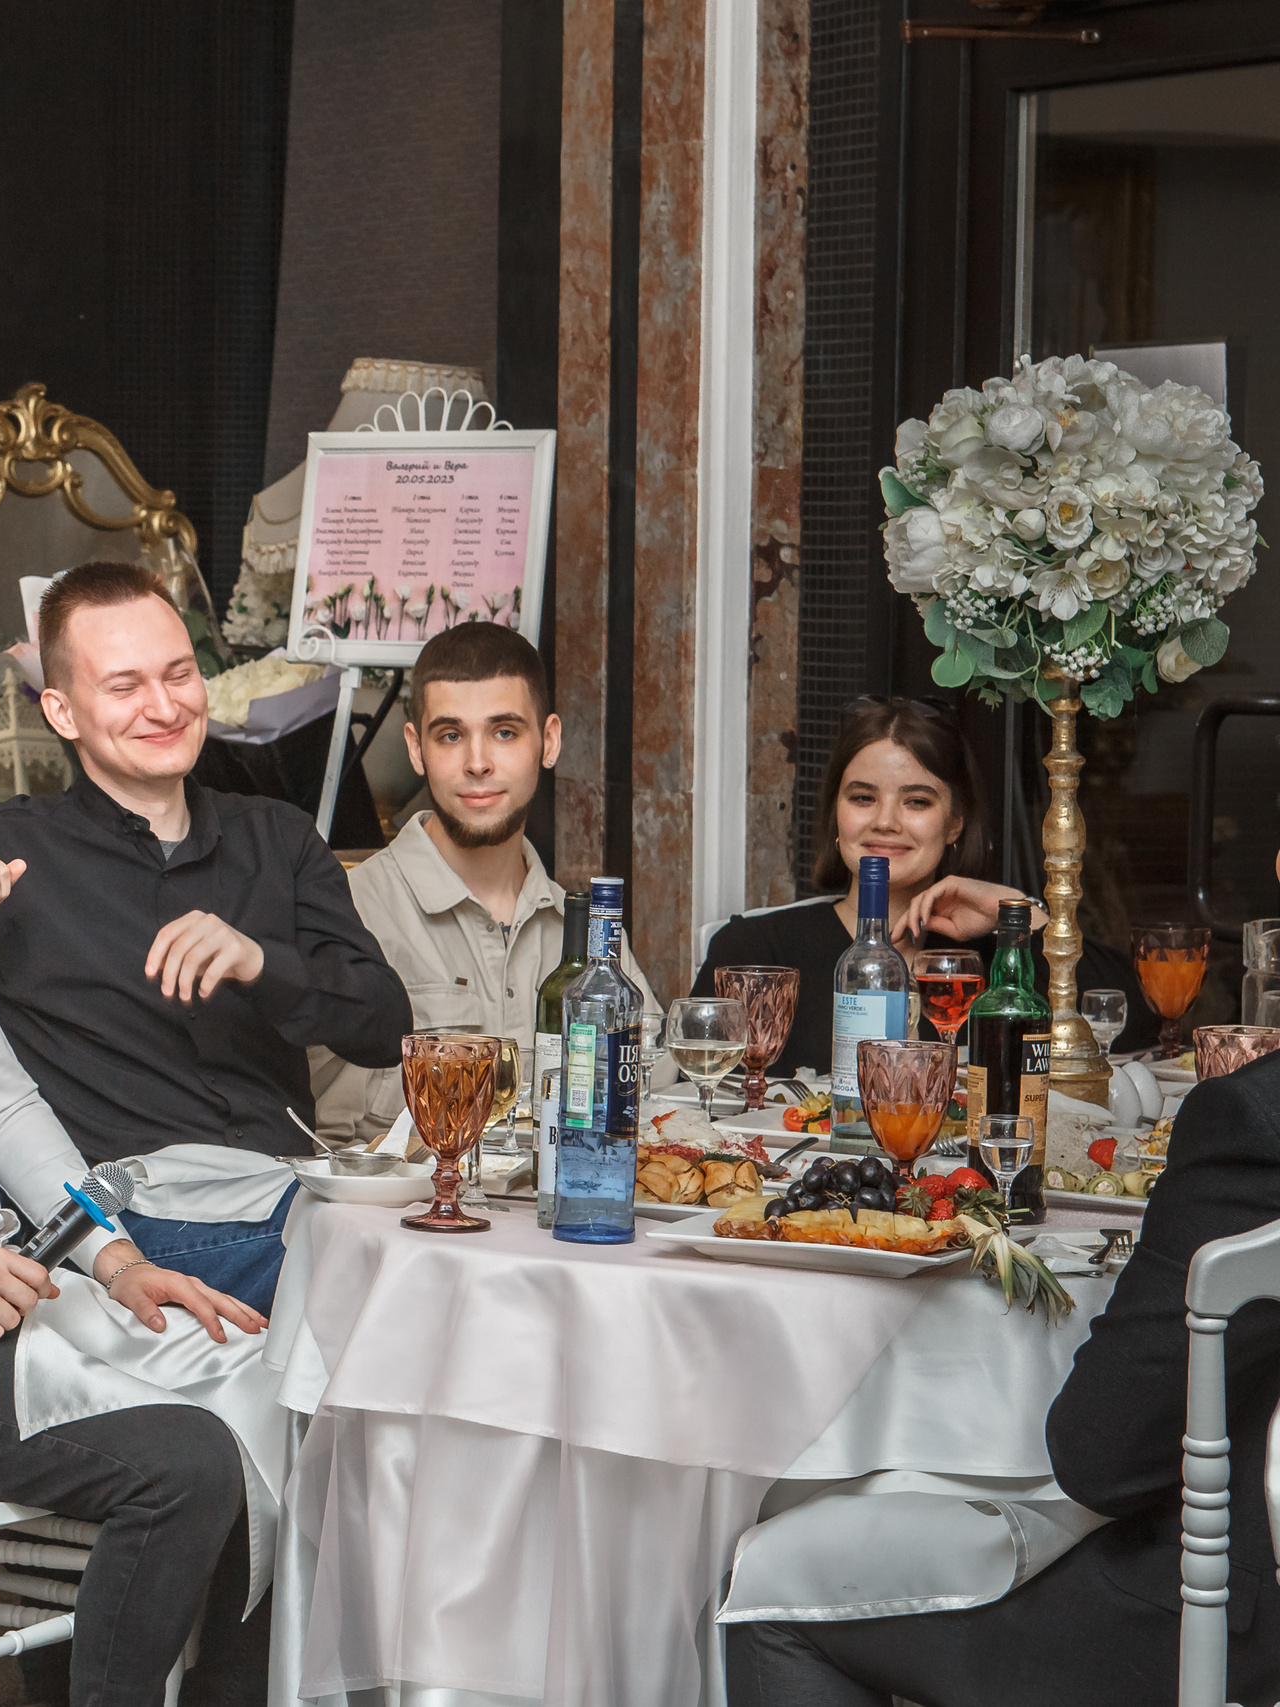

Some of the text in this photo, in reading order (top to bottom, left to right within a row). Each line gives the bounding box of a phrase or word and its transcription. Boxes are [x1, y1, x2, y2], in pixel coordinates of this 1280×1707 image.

[386, 461, 430, 472] Валерий
[444, 461, 469, 473] Вера
[395, 474, 455, 484] 20.05.2023
[842, 996, 857, 1006] ESTE
